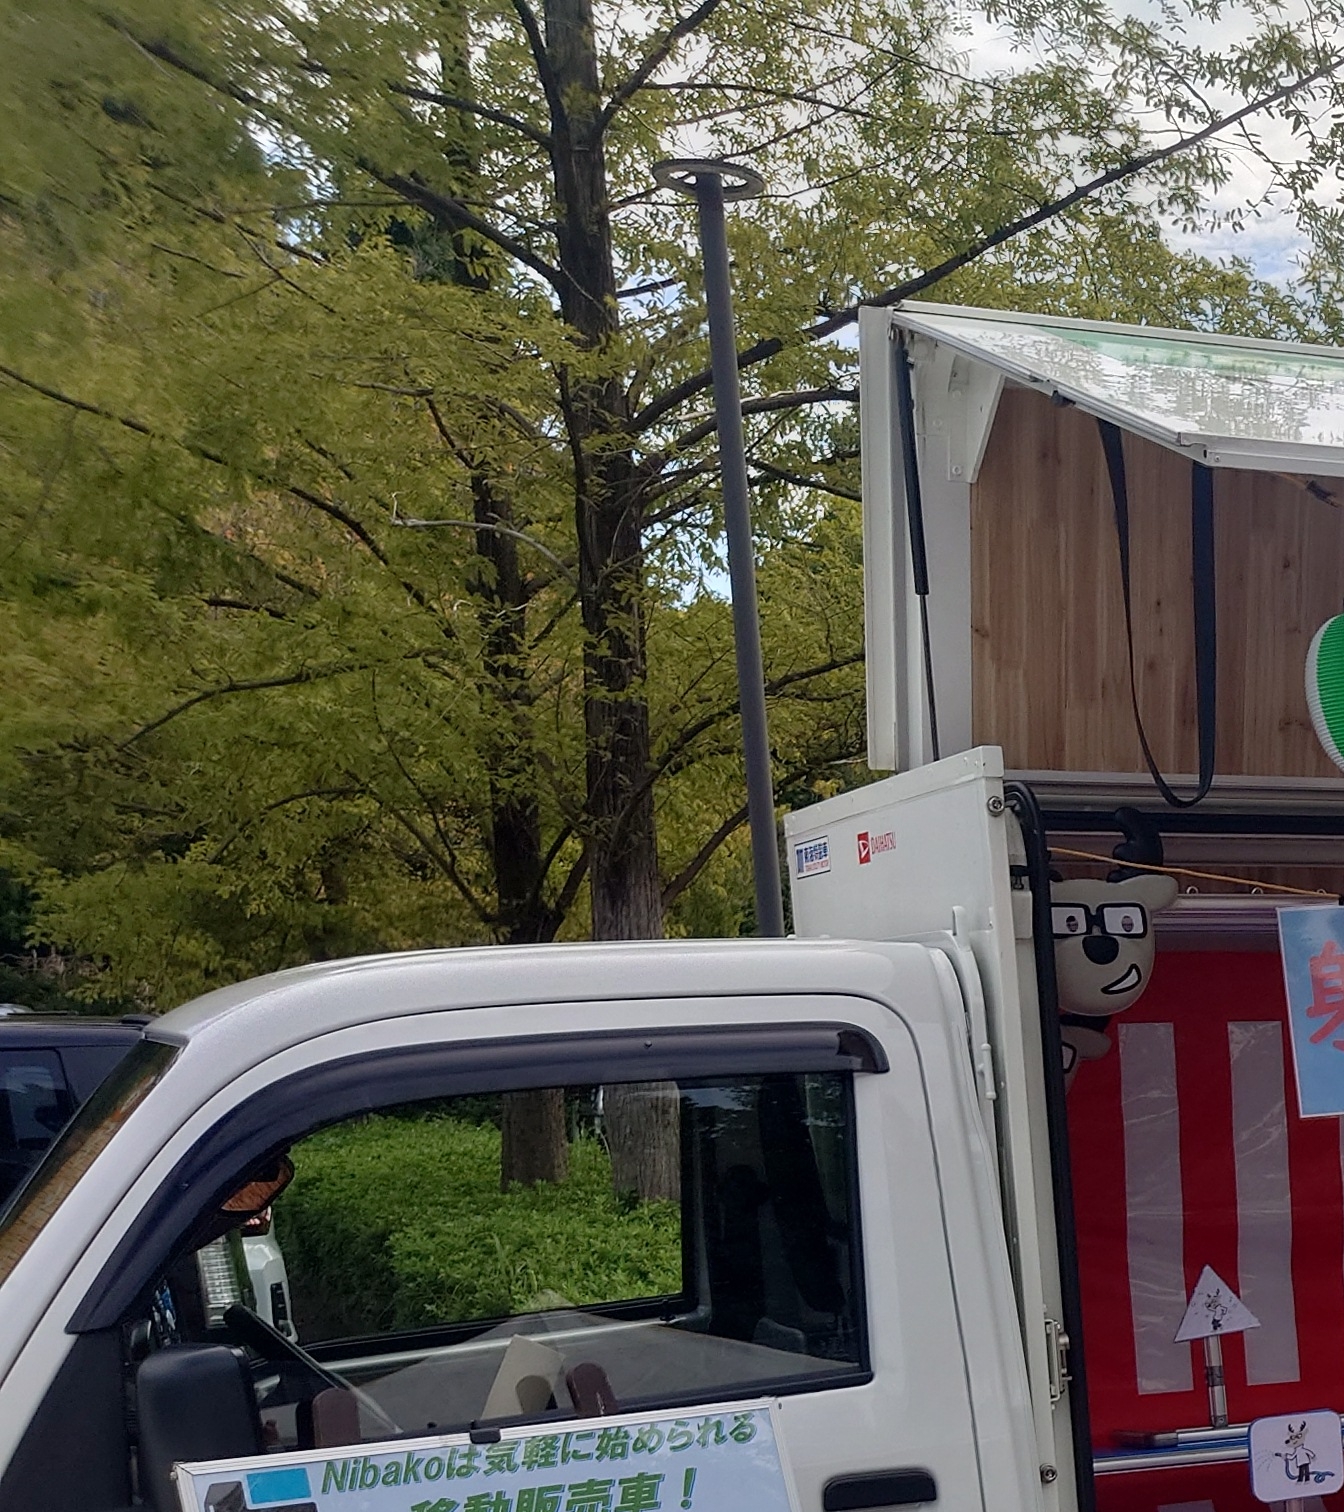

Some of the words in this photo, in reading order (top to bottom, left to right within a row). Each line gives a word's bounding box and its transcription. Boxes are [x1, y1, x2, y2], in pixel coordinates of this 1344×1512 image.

[314, 1411, 761, 1496] Nibakoは気軽に始められる
